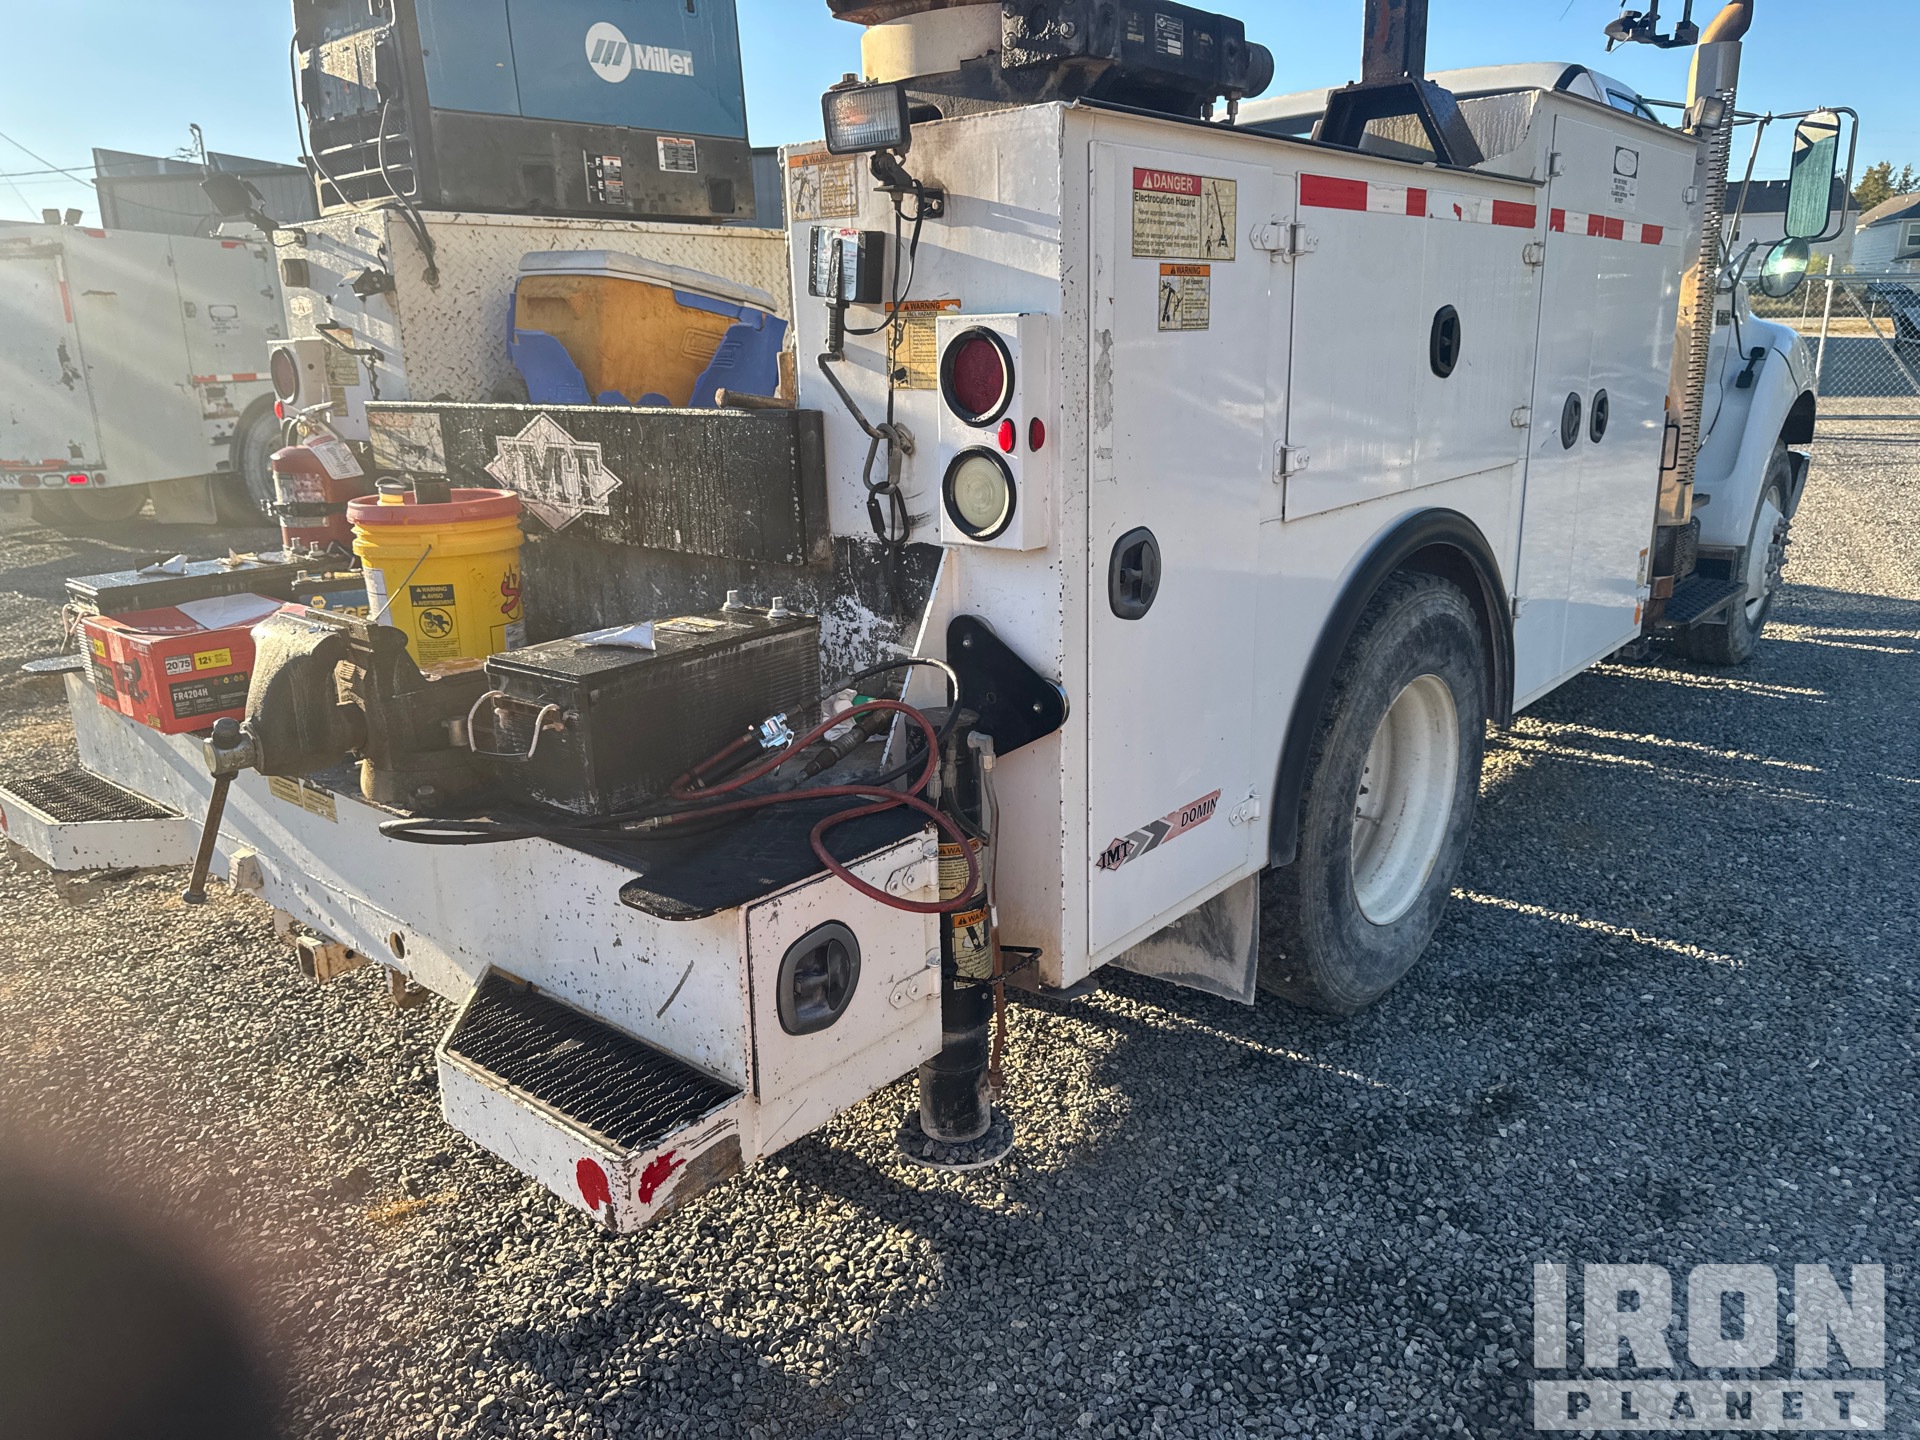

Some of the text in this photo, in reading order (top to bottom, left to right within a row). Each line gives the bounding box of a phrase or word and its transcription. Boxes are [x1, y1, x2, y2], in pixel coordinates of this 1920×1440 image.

[634, 43, 691, 76] Miller
[595, 158, 605, 201] FUEL
[1154, 174, 1192, 192] DANGER
[1134, 192, 1195, 207] Electrocution Hazard
[1177, 266, 1200, 274] WARNING
[910, 302, 940, 310] WARNING
[496, 436, 610, 515] IMT
[166, 660, 190, 670] 20 75
[173, 688, 209, 701] FR4204H
[1100, 840, 1130, 870] IMT
